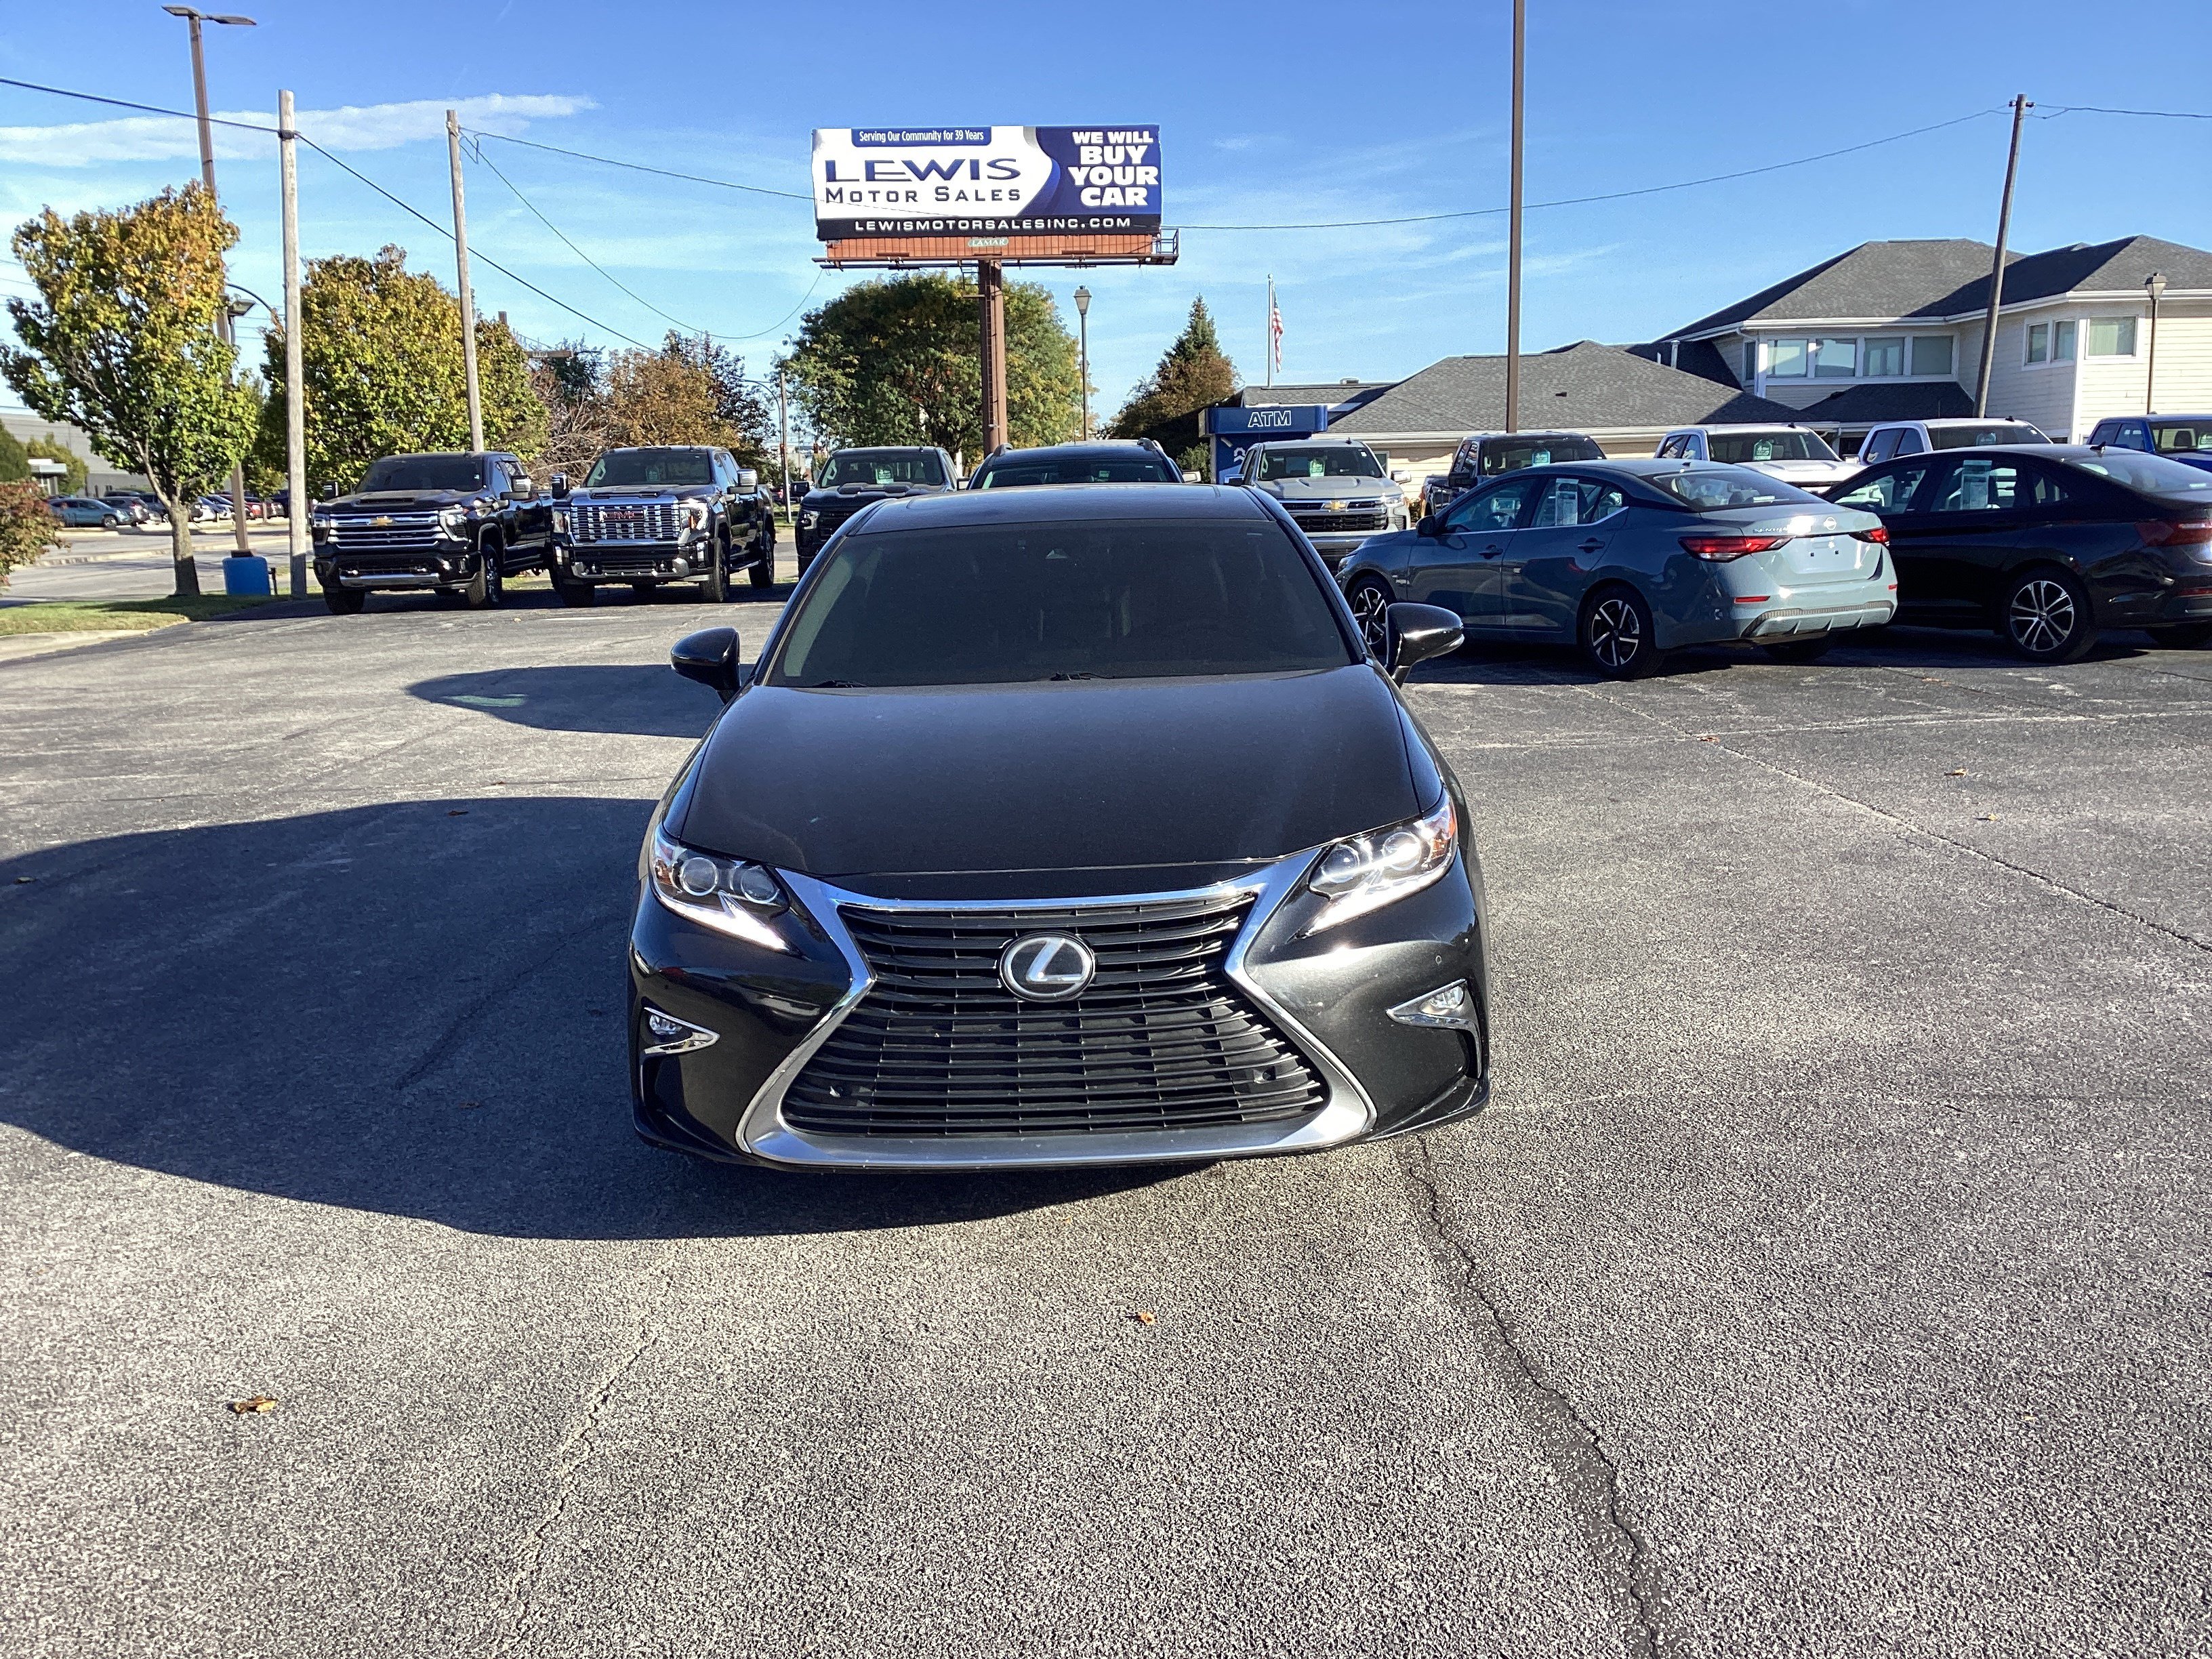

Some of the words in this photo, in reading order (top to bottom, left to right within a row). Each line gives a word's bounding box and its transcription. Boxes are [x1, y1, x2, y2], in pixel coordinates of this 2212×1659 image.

[859, 131, 886, 143] Serving
[887, 132, 900, 142] Our
[901, 130, 941, 143] Community
[943, 130, 953, 140] for
[954, 129, 964, 140] 39
[964, 129, 983, 140] Years
[1071, 131, 1104, 144] WE
[1107, 131, 1154, 144] WILL
[1080, 145, 1148, 165] BUY
[825, 158, 1021, 182] LEWIS
[1067, 165, 1160, 186] YOUR
[1080, 186, 1149, 206] CAR
[855, 218, 1131, 230] LEWISMOTORSALESINC.COM
[972, 239, 1006, 247] LAMAR
[1247, 410, 1292, 428] ATM
